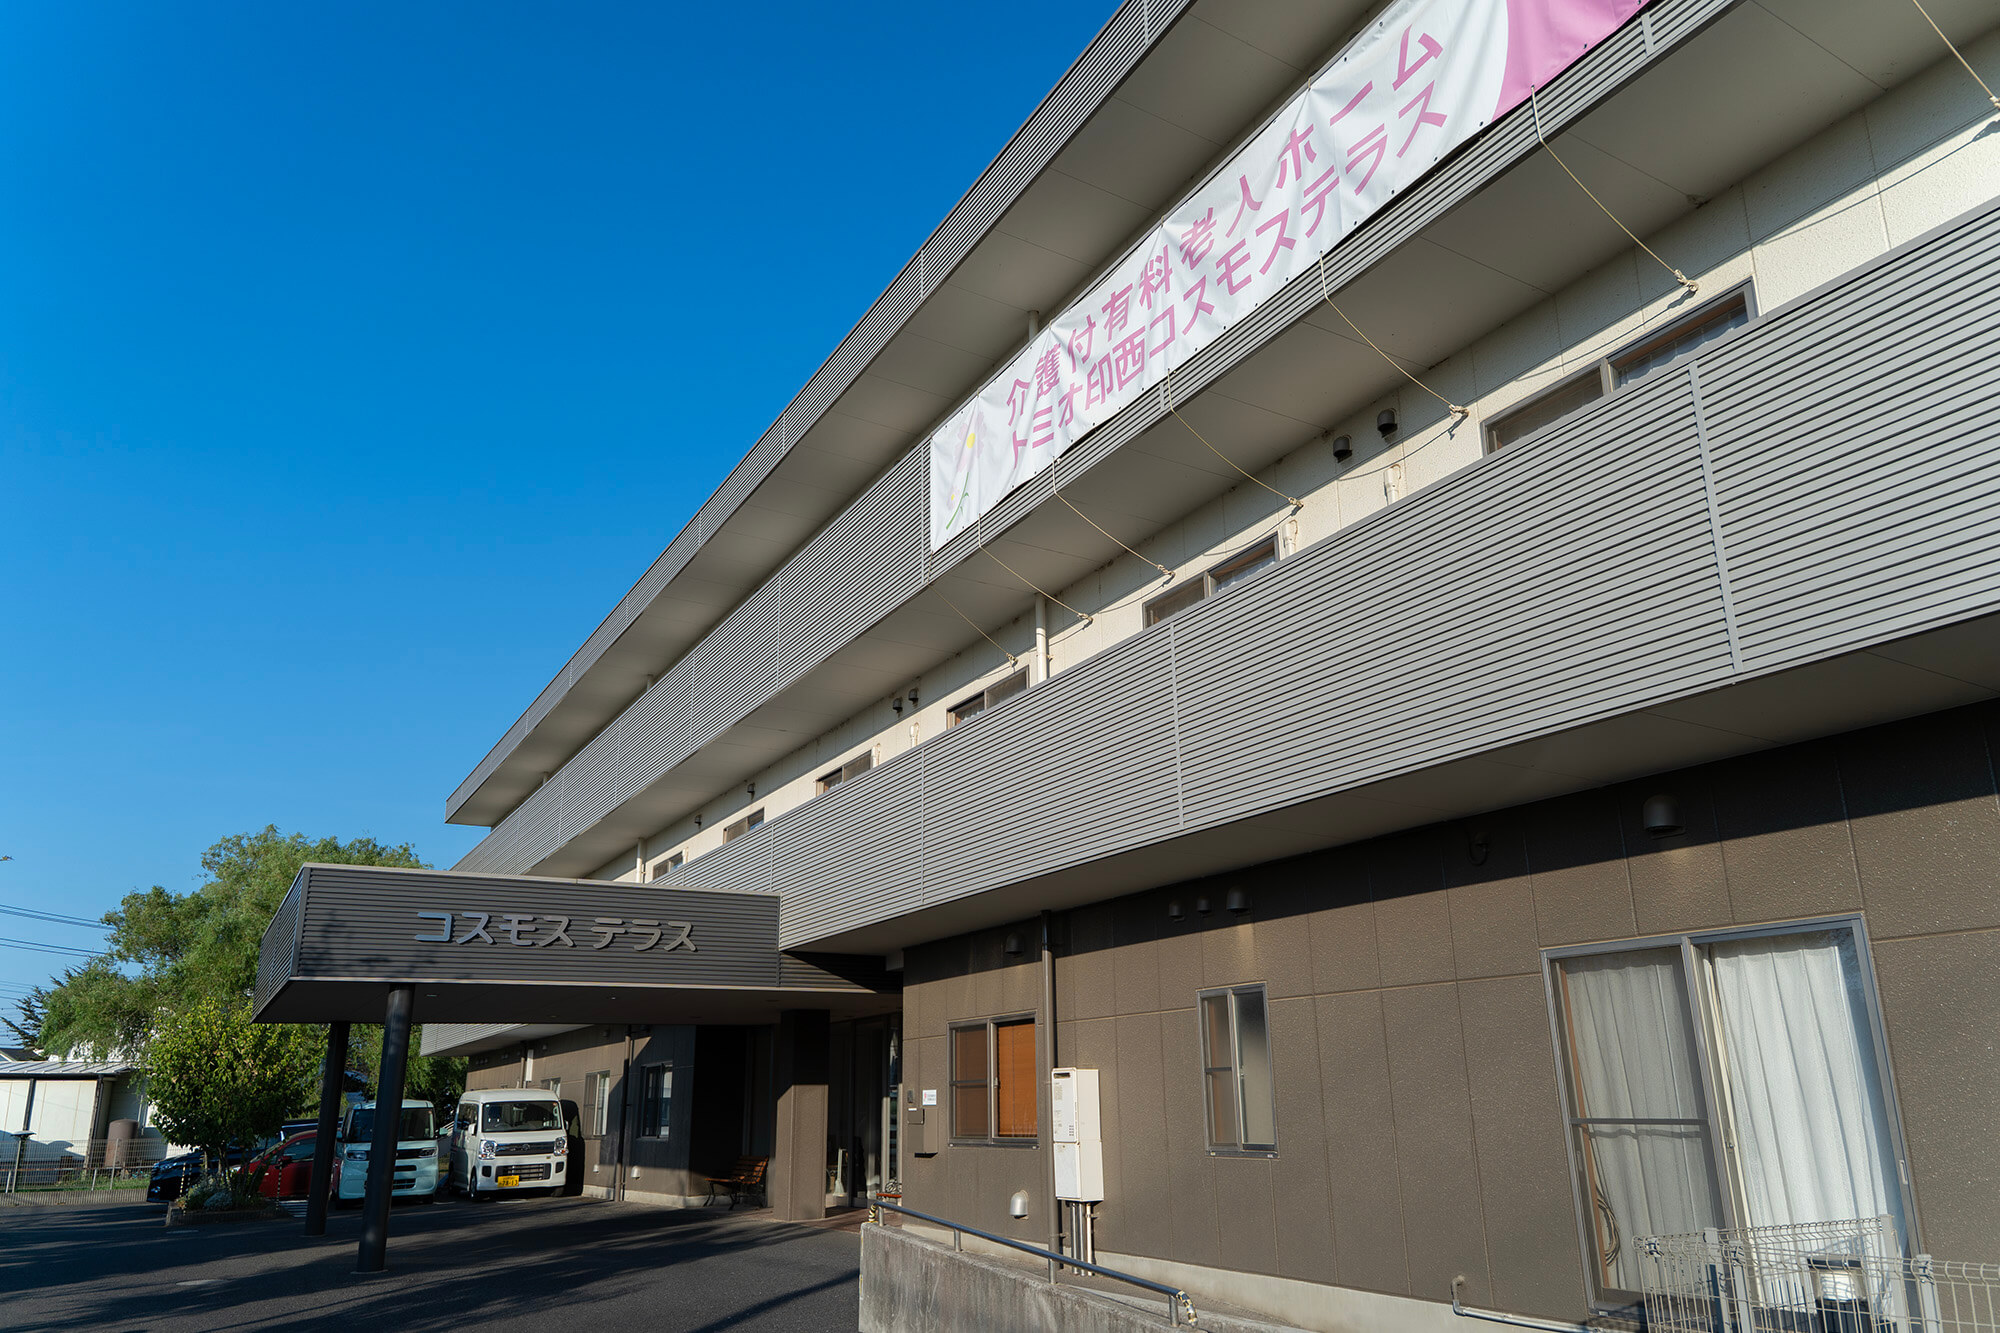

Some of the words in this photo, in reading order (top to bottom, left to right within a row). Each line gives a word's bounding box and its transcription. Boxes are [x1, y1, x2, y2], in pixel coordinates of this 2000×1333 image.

[1006, 24, 1443, 427] 介護付有料老人ホーム
[1012, 79, 1448, 470] トミオ印西コスモステラス
[414, 911, 574, 947] コスモス
[590, 917, 697, 951] テラス
